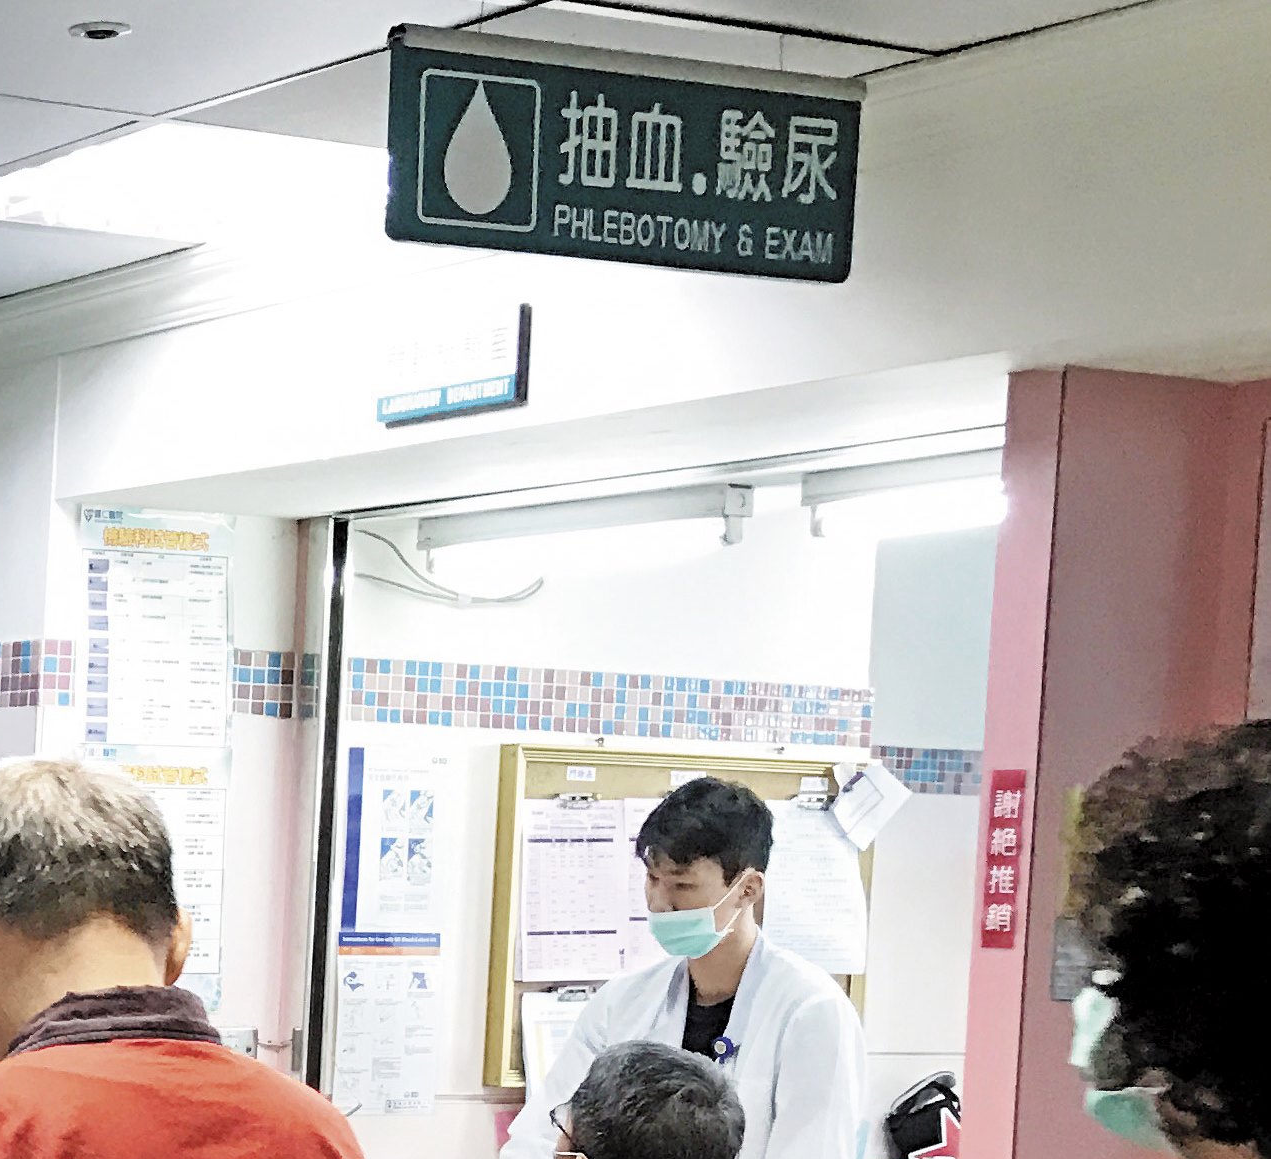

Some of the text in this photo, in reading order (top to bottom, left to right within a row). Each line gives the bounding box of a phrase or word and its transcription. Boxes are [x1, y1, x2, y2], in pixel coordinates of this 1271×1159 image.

[553, 204, 833, 265] PHLEBOTOMY & EXAM
[985, 789, 1022, 932] 謝絕推銷
